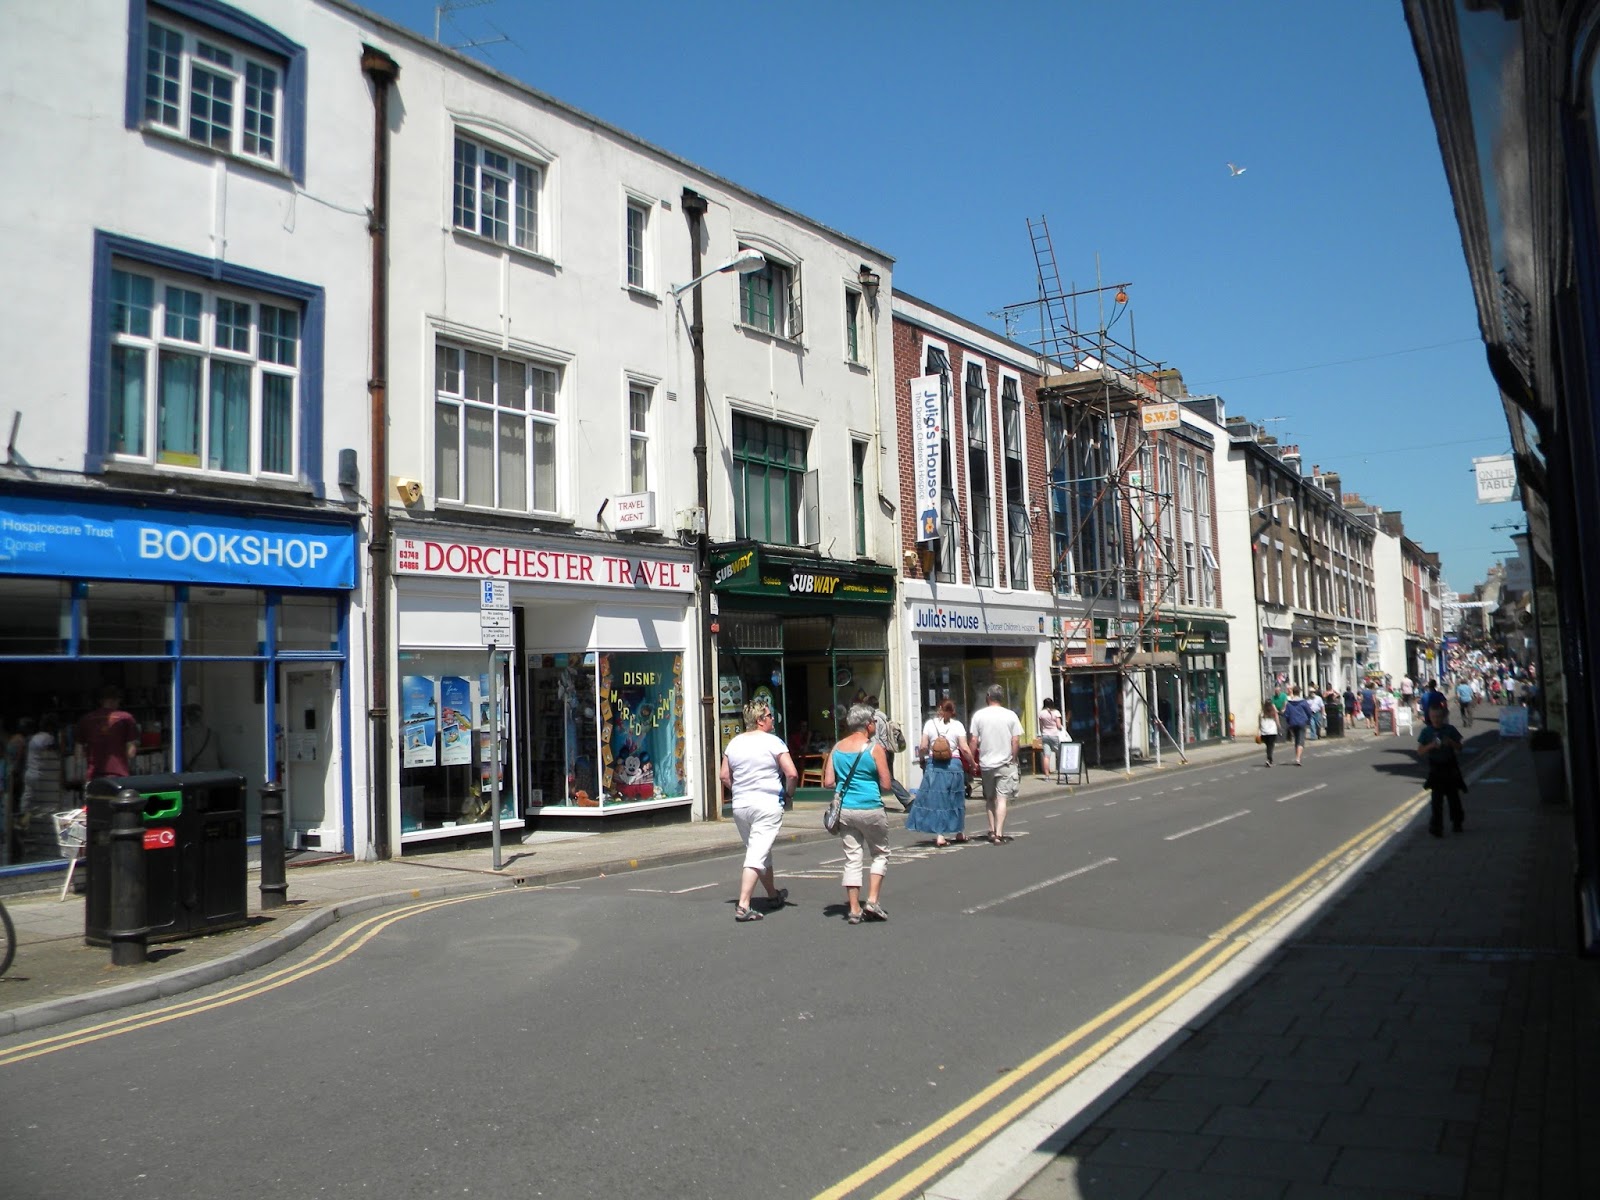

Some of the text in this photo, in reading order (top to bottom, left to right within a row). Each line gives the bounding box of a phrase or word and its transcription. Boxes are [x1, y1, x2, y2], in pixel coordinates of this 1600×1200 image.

[924, 390, 940, 499] Julia's House
[1479, 468, 1514, 479] ON THE
[1480, 479, 1515, 490] TABLE
[618, 500, 645, 511] TRAVEL
[620, 512, 644, 523] AGENT
[3, 518, 114, 538] Hospicecare Trust
[5, 537, 47, 552] Dorset
[139, 527, 329, 569] BOOKSHOP
[404, 540, 414, 549] TEL
[424, 541, 594, 582] DORCHESTER
[602, 557, 681, 588] TRAVEL
[715, 551, 753, 584] SUBWAY
[789, 573, 840, 594] SUBWAY
[916, 609, 947, 629] Julia's
[949, 611, 979, 630] House
[623, 672, 662, 686] DISNEY
